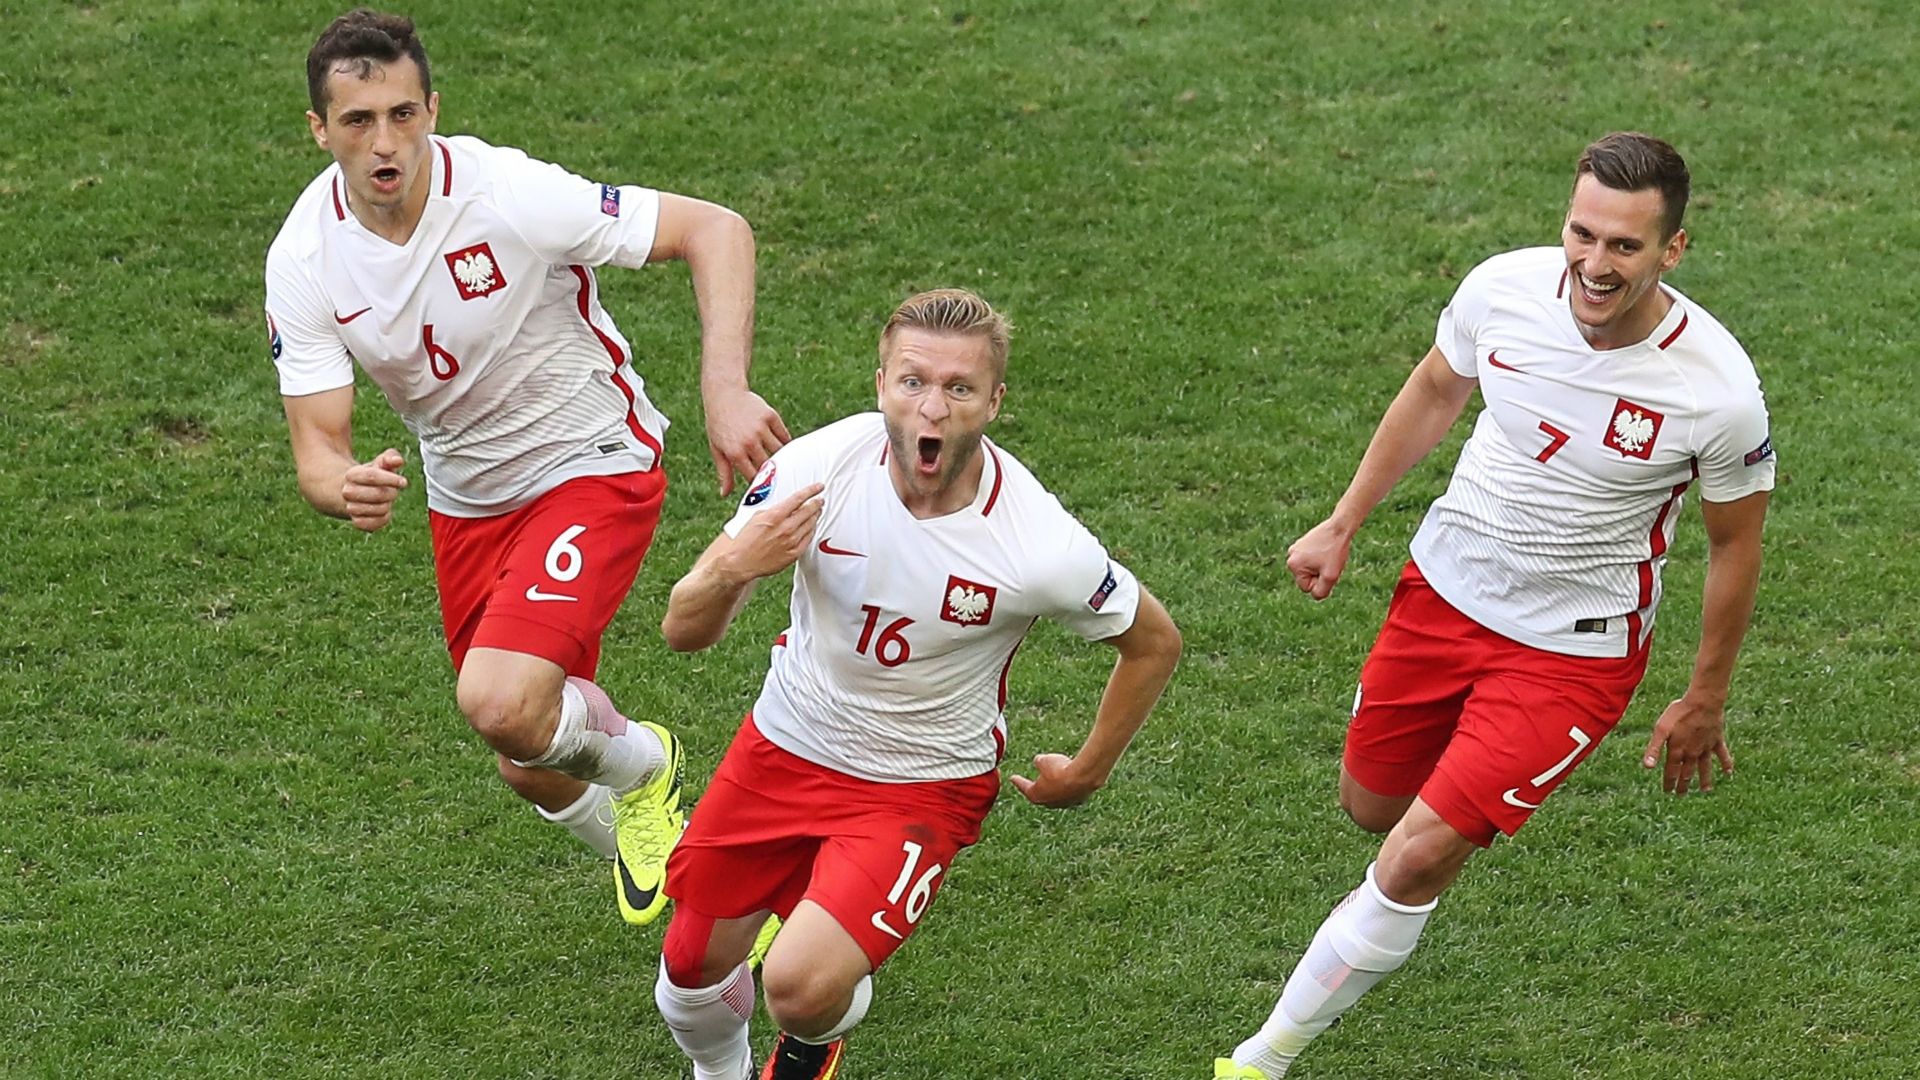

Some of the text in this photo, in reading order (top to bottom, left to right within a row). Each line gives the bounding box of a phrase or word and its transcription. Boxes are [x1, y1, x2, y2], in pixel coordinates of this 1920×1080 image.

[423, 324, 460, 380] 6
[1538, 421, 1571, 464] 7
[545, 524, 587, 582] 6
[856, 604, 915, 667] 16
[1531, 725, 1591, 787] 7
[887, 841, 942, 925] 16
